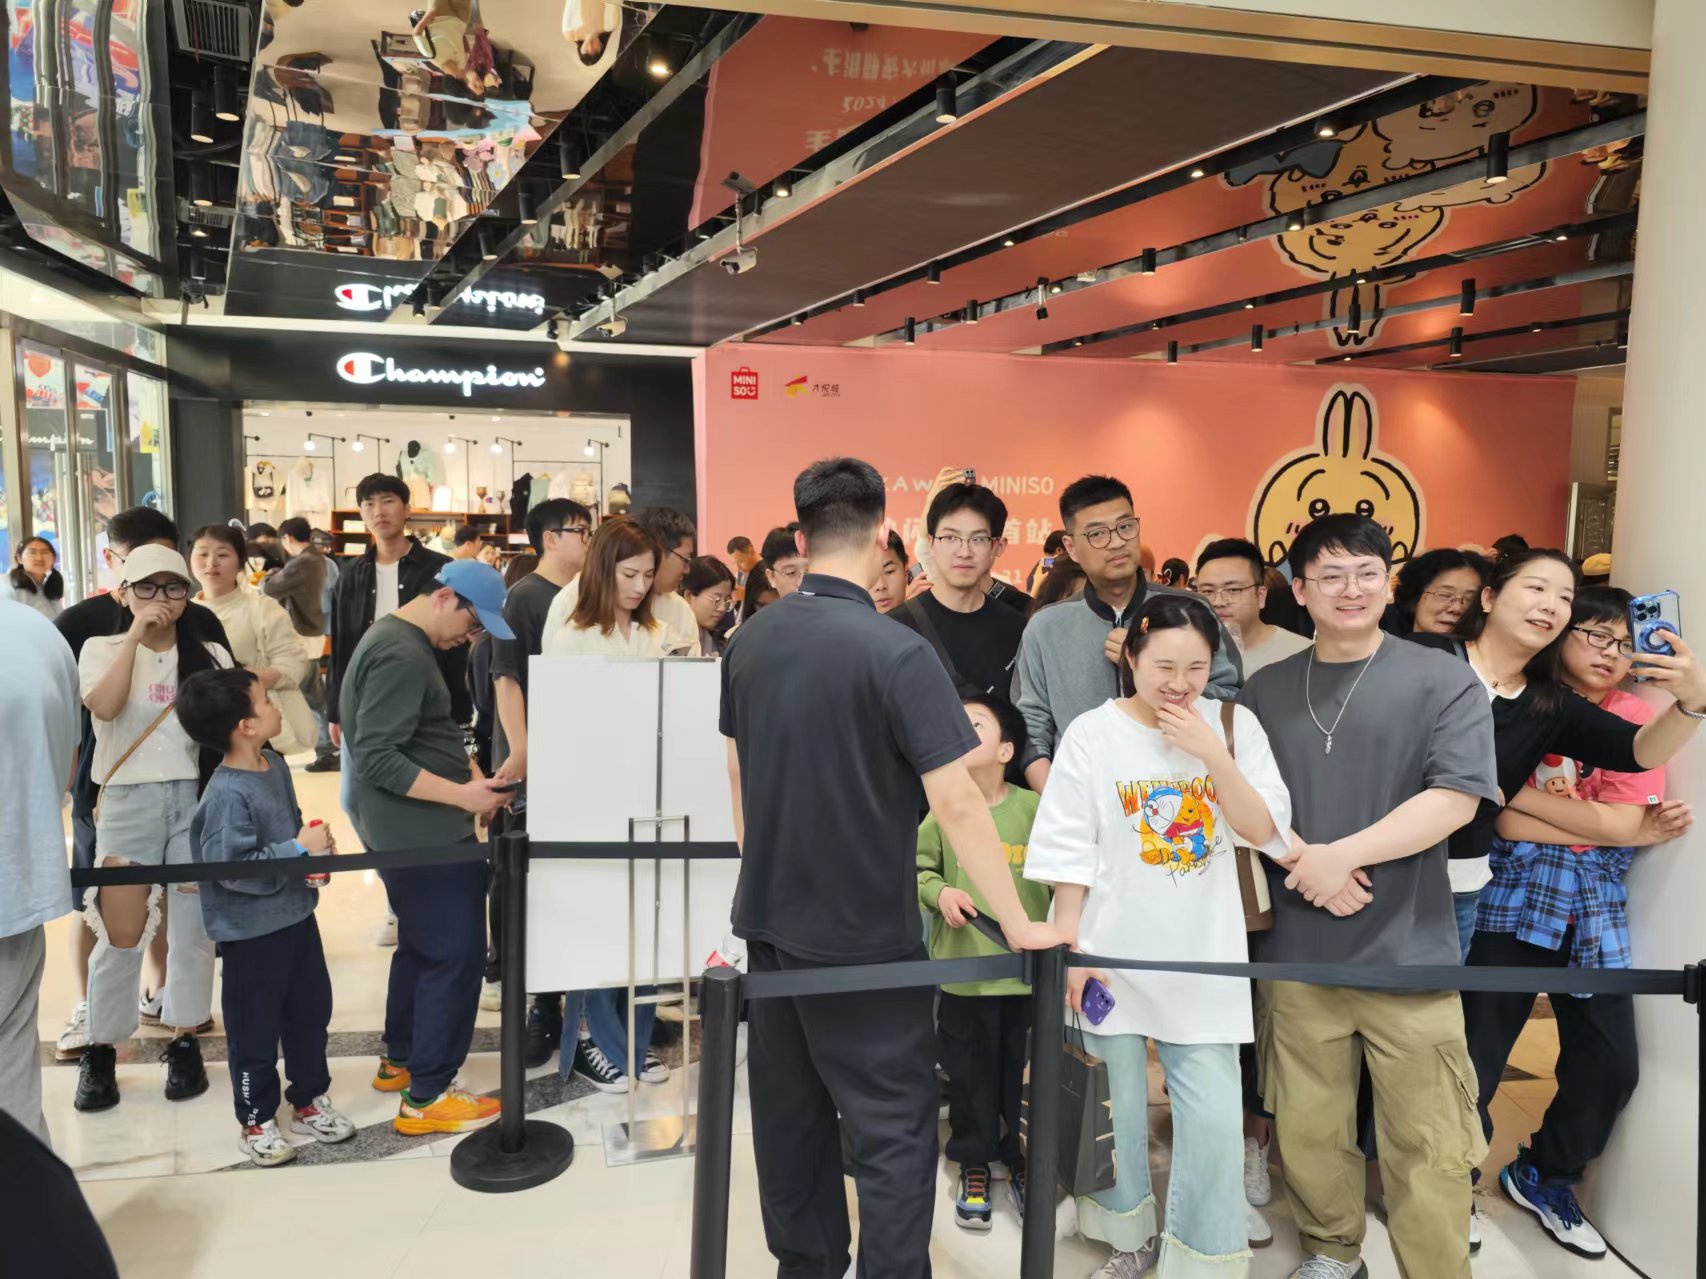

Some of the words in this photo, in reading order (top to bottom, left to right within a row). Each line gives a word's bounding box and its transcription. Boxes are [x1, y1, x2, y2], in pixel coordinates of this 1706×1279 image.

[336, 352, 546, 397] Champion
[733, 375, 757, 385] MINI
[980, 476, 1054, 496] MINISO
